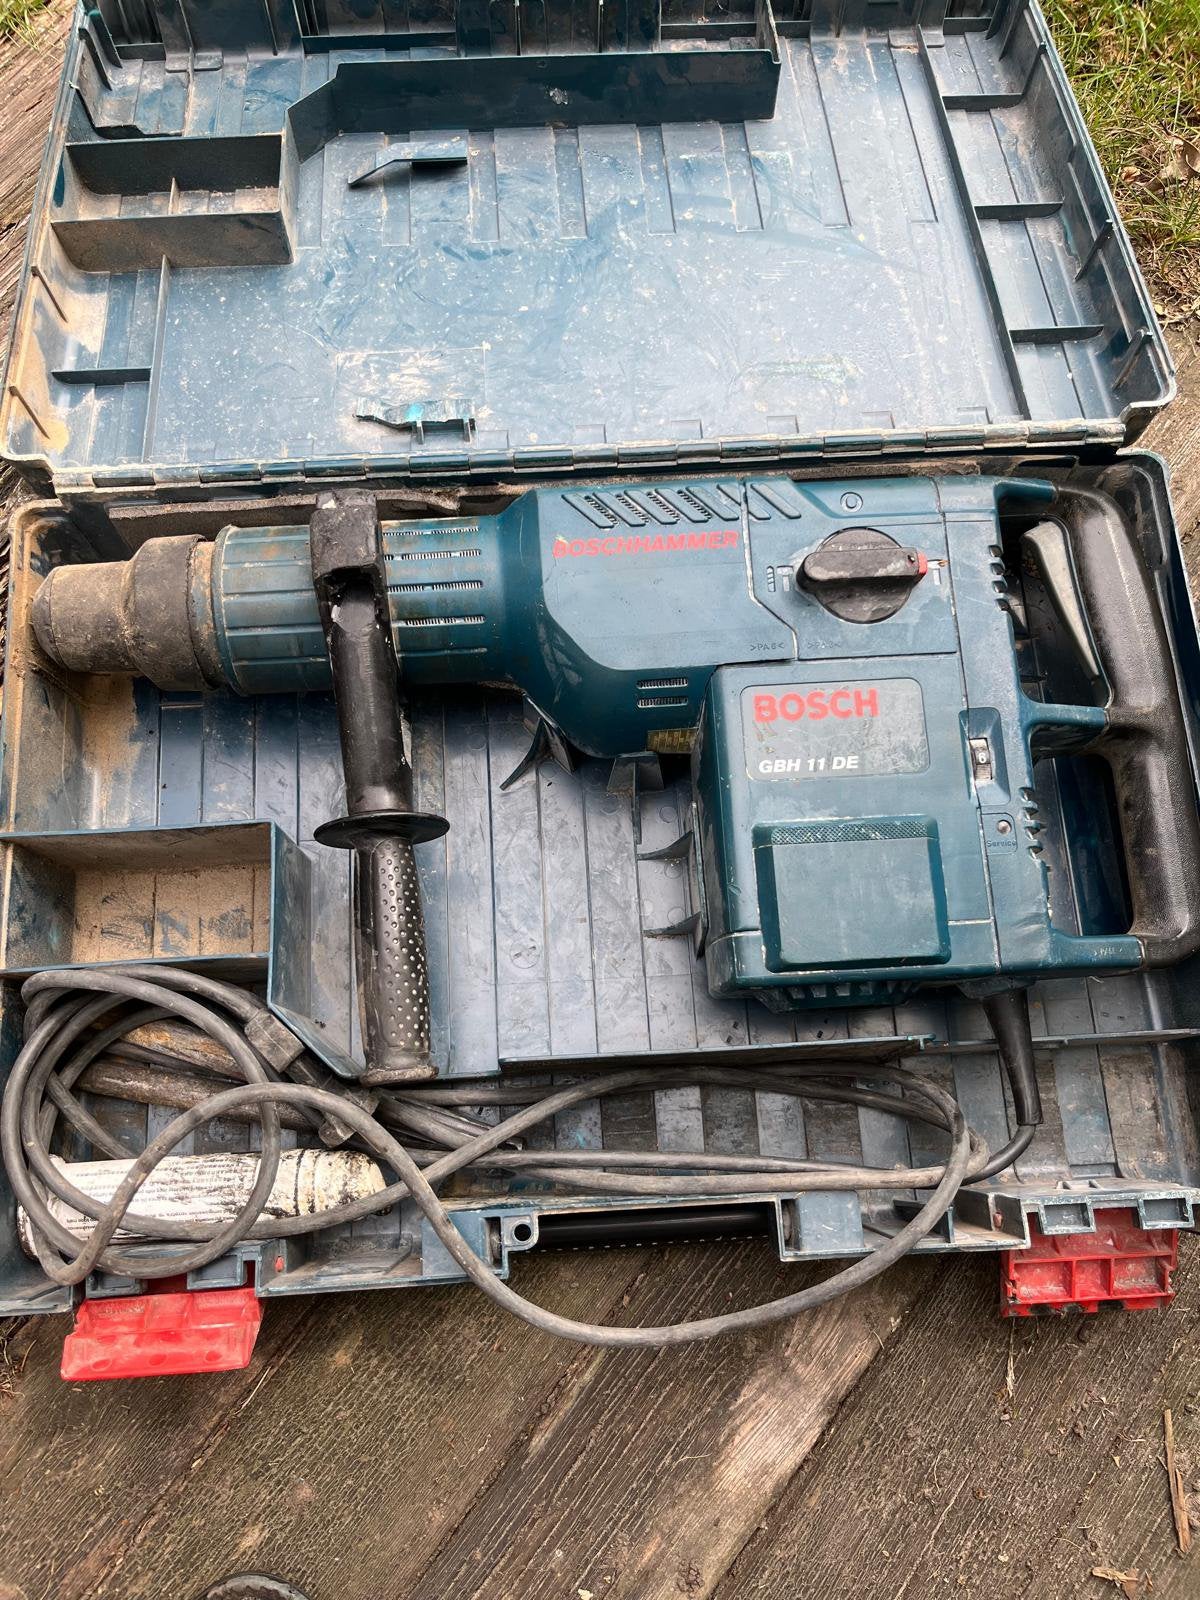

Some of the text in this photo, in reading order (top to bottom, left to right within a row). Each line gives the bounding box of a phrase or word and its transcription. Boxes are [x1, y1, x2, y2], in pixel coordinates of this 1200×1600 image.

[552, 530, 740, 558] BOSCHHAMMER
[753, 688, 879, 723] BOSCH
[758, 755, 860, 774] GBH 11 DE
[978, 752, 986, 764] 6
